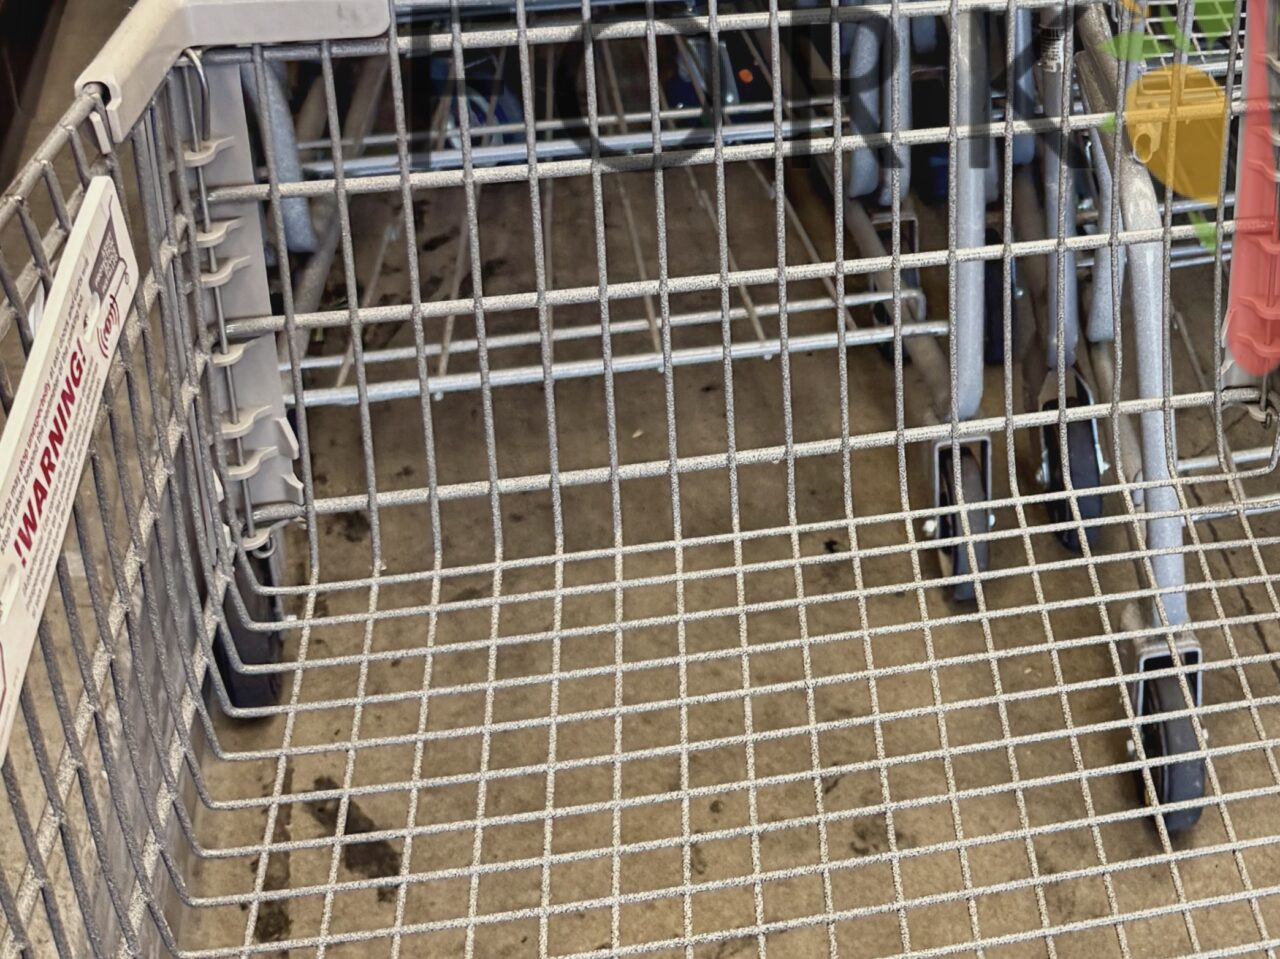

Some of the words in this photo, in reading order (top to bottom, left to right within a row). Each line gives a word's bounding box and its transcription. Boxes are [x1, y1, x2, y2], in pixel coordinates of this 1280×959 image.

[10, 473, 20, 498] may
[18, 448, 29, 474] stop
[27, 382, 50, 448] unexpectedly
[23, 442, 39, 484] beyond
